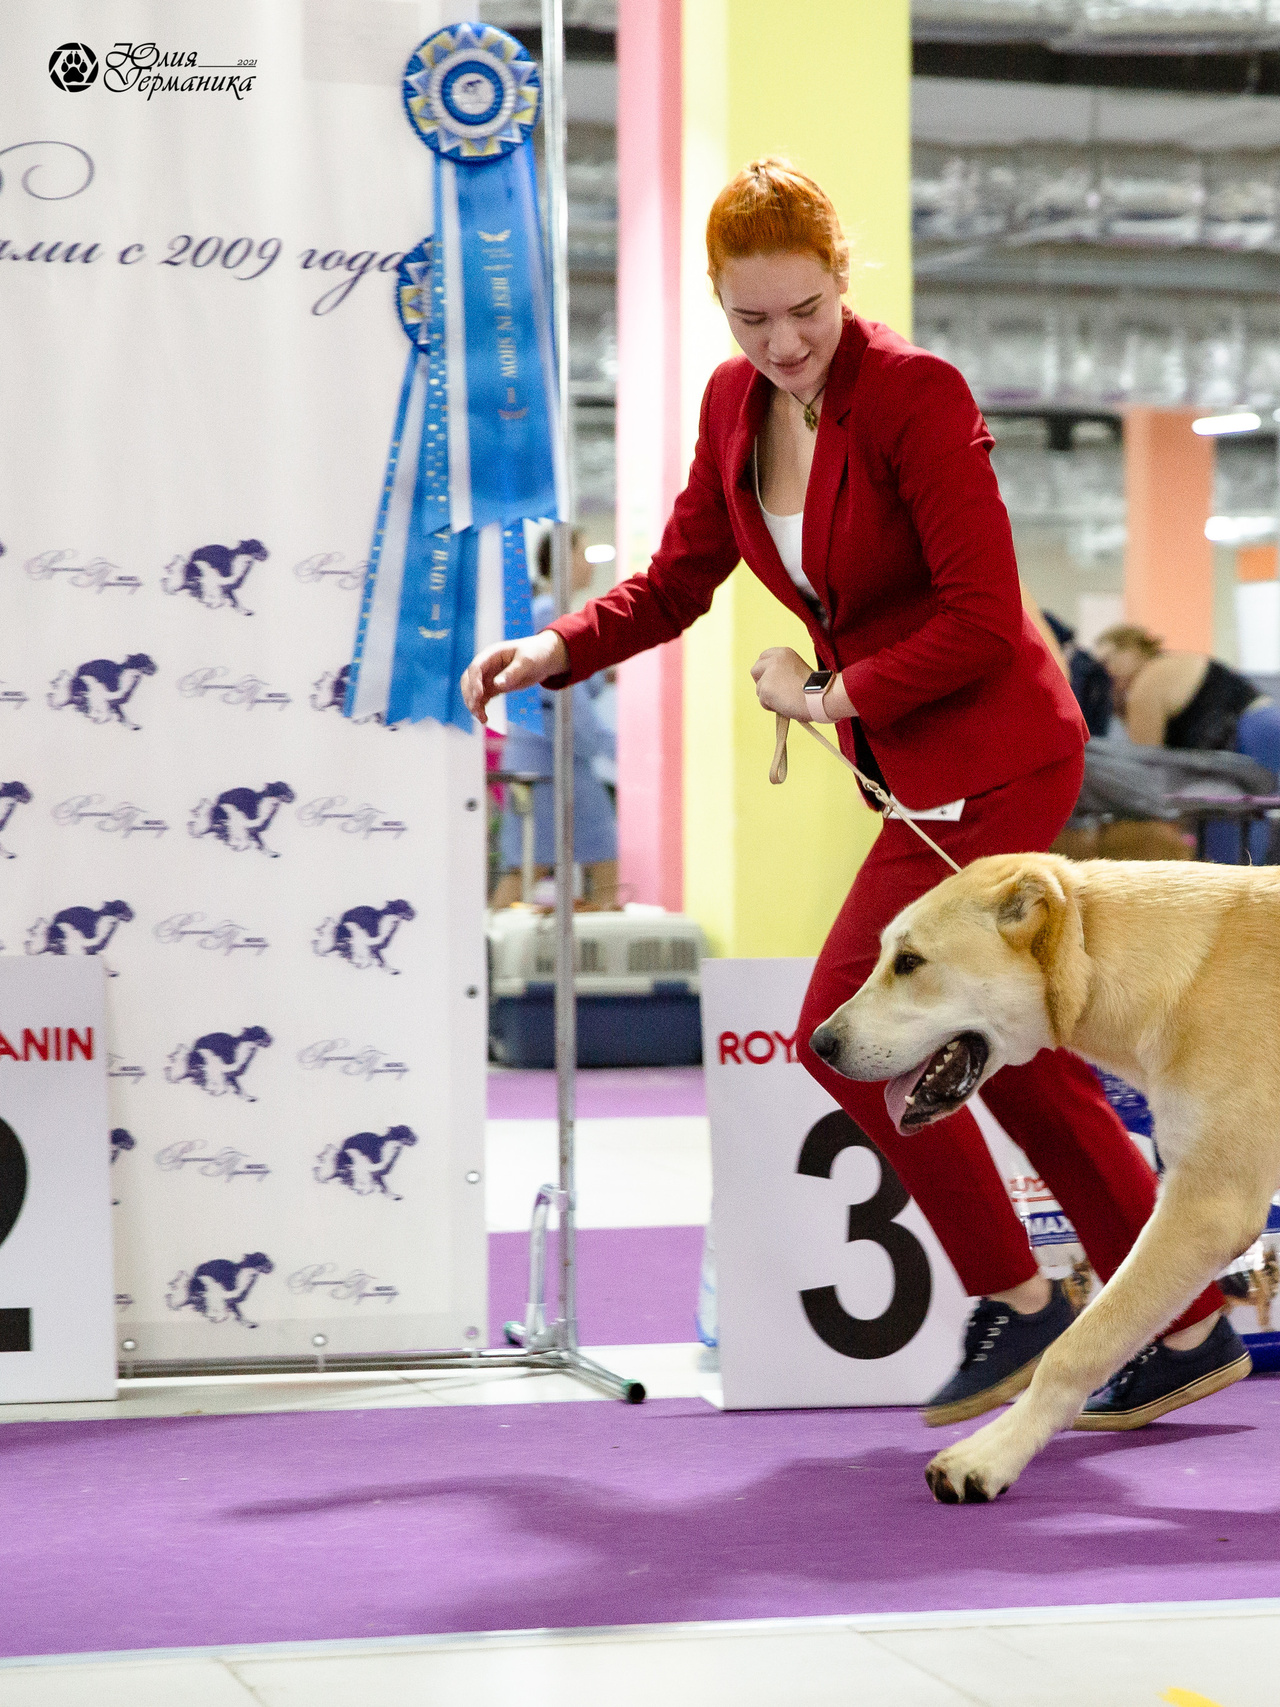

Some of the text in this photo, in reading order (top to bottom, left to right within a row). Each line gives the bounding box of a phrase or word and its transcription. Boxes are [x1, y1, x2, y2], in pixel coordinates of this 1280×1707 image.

[117, 241, 147, 265] с
[159, 234, 284, 281] 2009
[297, 249, 403, 316] года
[497, 336, 518, 378] SHOW
[719, 1030, 801, 1065] ROY
[797, 1108, 932, 1359] 3
